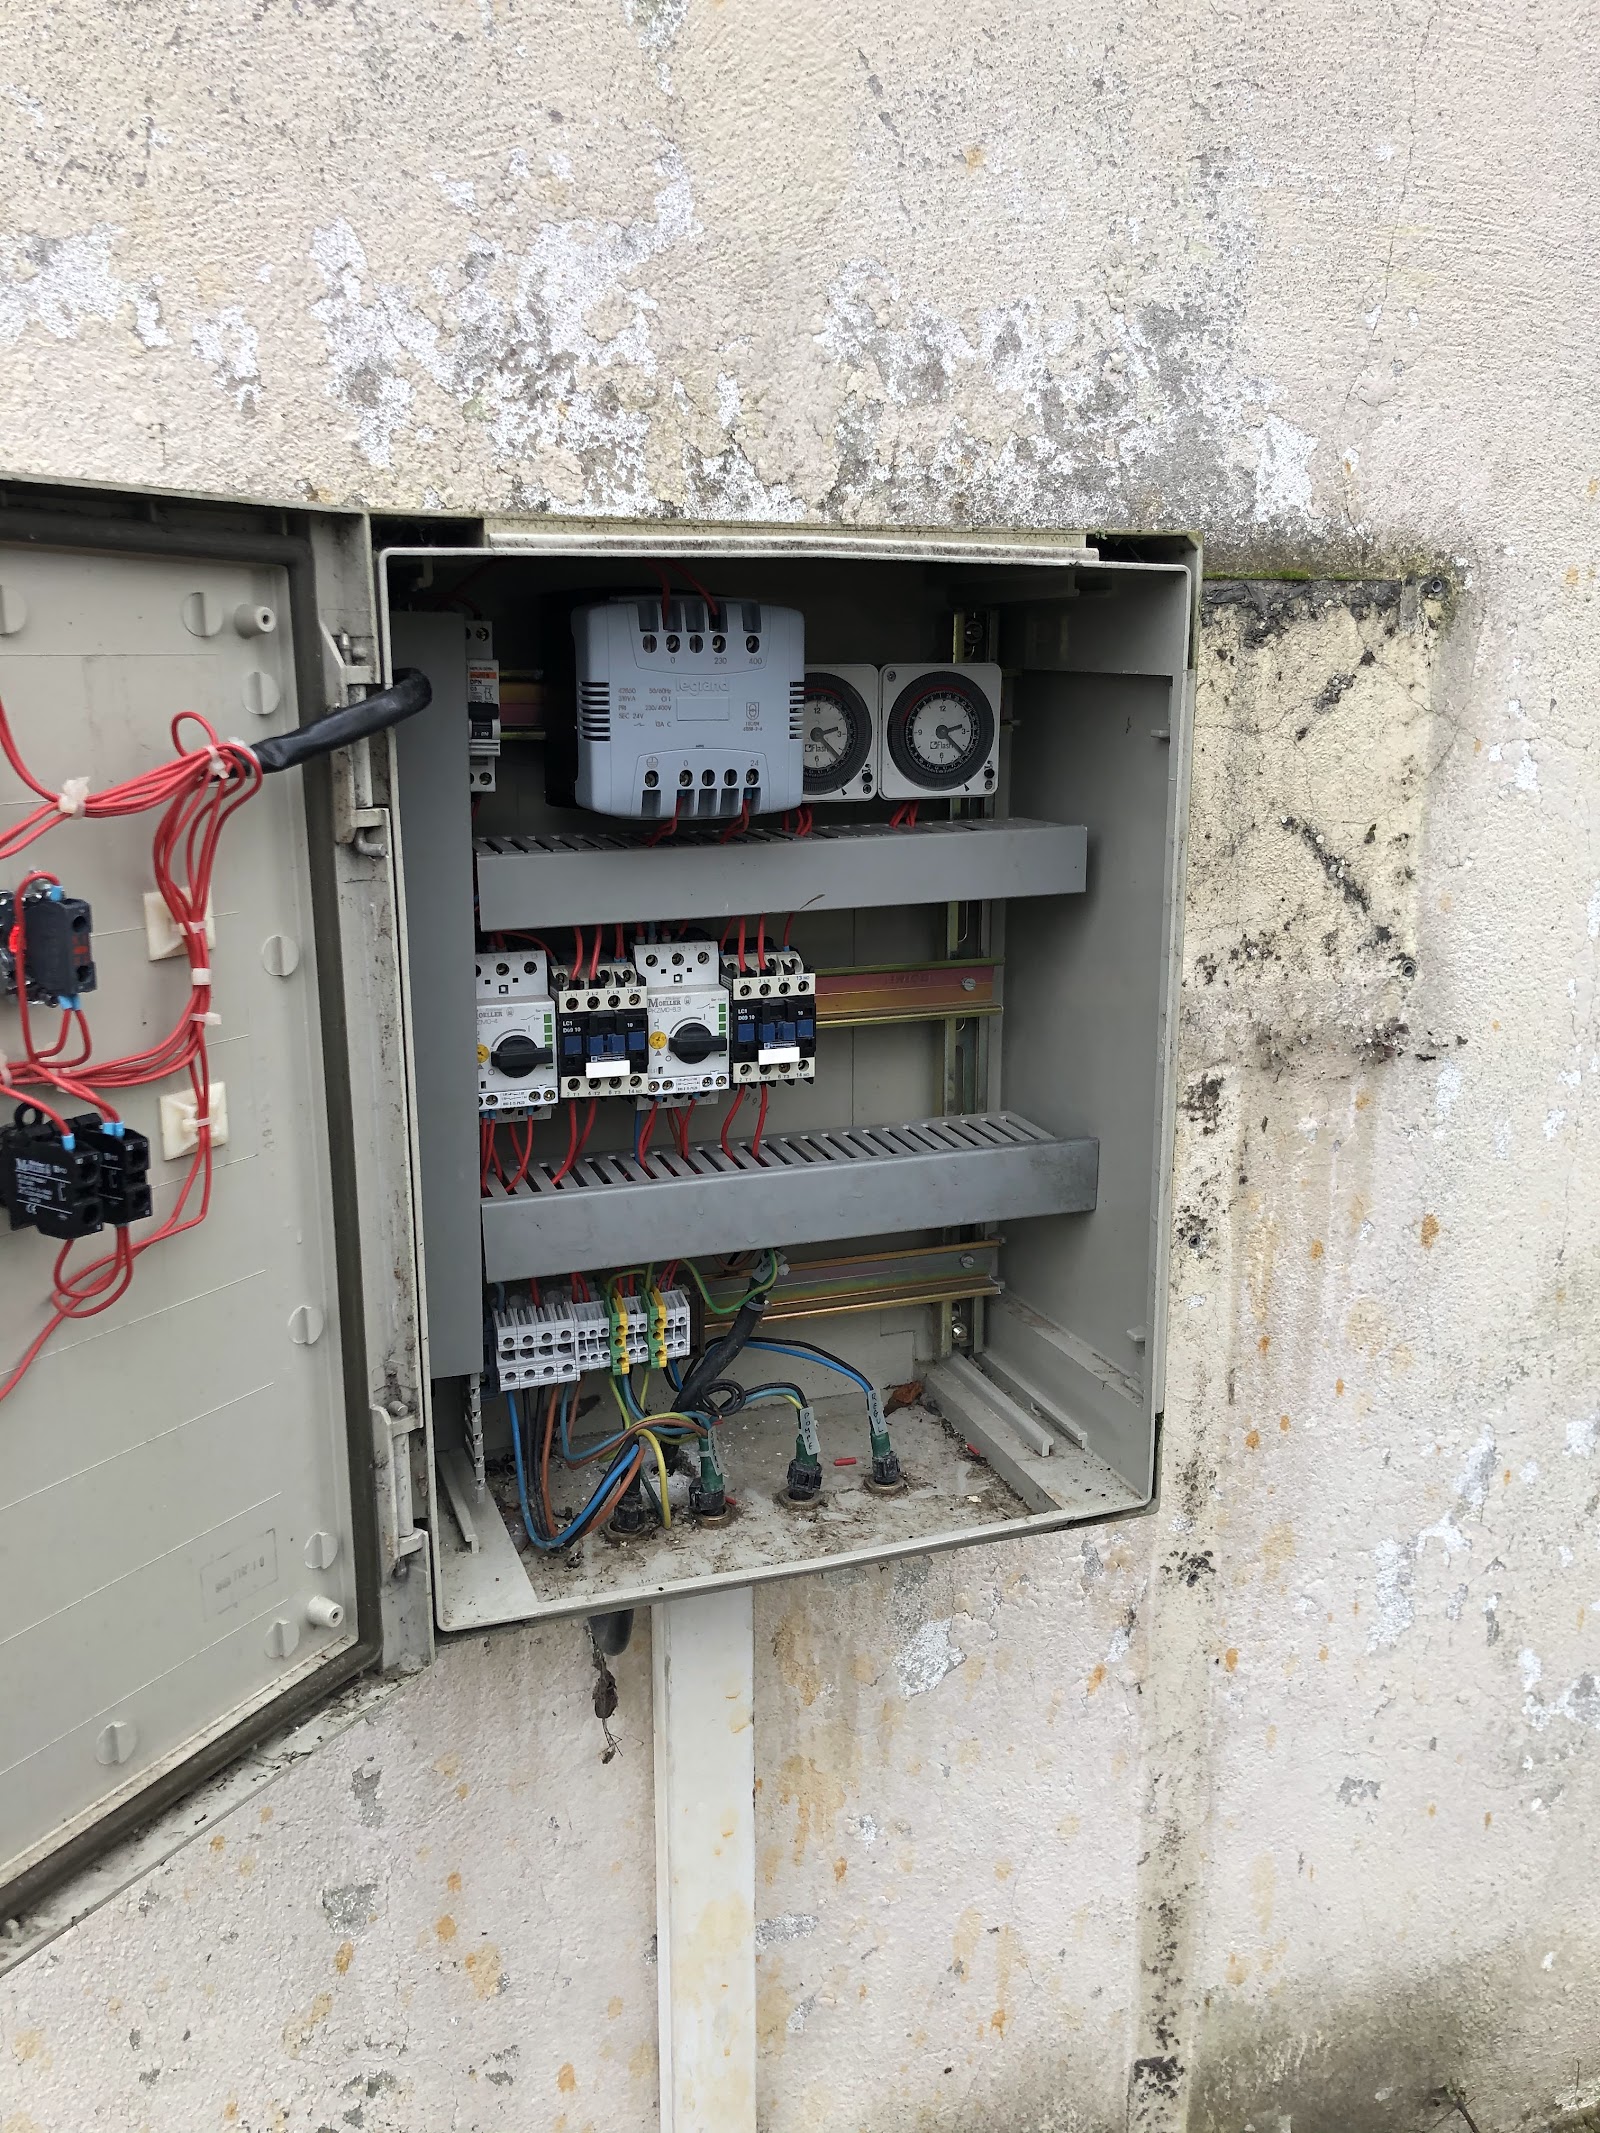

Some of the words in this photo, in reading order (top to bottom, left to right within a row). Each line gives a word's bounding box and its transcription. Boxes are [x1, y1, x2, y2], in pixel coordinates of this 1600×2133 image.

[714, 657, 728, 665] 230
[748, 657, 763, 665] 400
[676, 677, 730, 696] legrand
[477, 1009, 503, 1019] OELLER
[803, 1412, 813, 1451] POMPE
